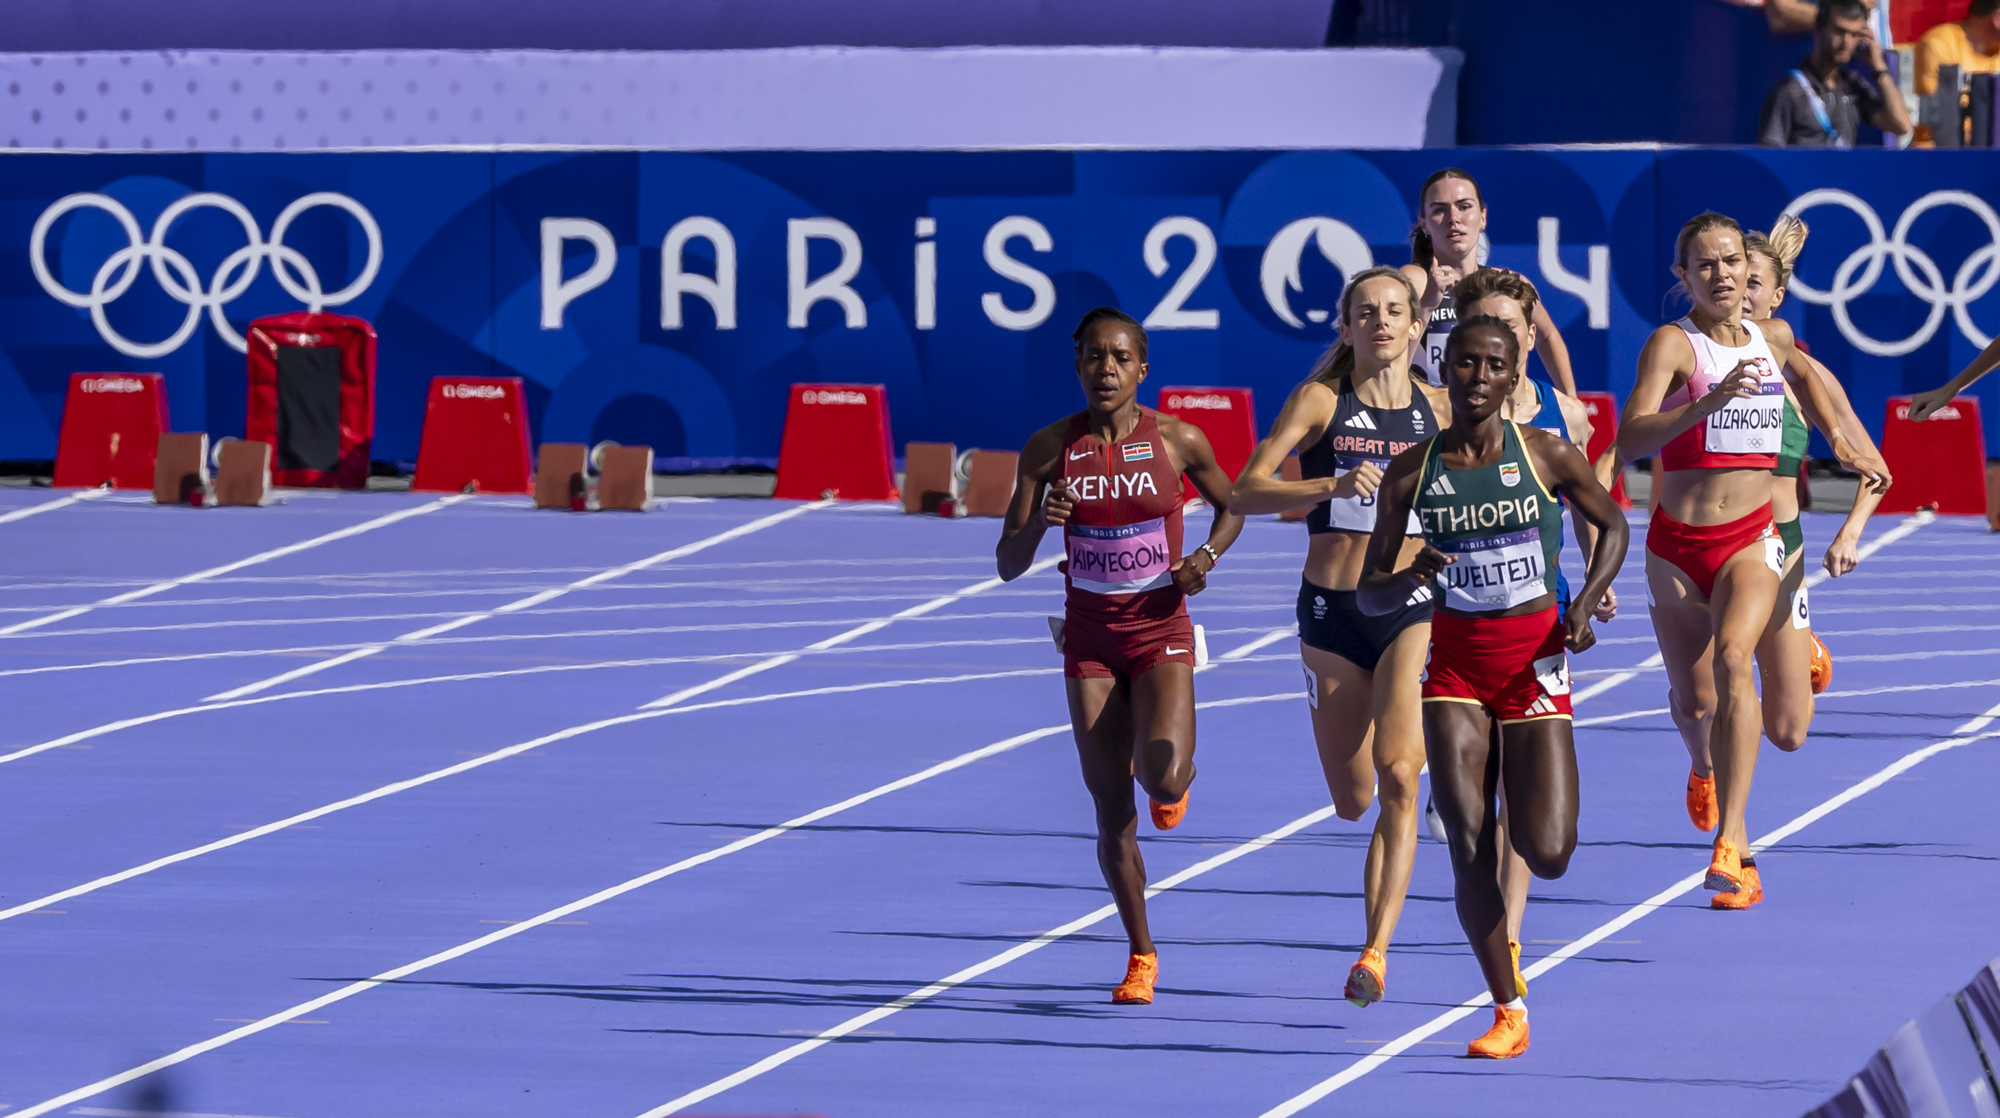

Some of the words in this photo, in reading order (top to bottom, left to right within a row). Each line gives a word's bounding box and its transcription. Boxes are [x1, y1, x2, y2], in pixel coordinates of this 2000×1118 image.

[1141, 215, 1610, 330] 204
[1431, 308, 1457, 321] NEW
[456, 383, 506, 399] OMEGA
[1333, 435, 1385, 455] GREAT
[1066, 471, 1158, 500] KENYA
[1420, 495, 1540, 533] ETHIOPIA
[1073, 543, 1165, 573] KIPYEGON
[1776, 546, 1783, 569] 5
[1447, 555, 1539, 590] WELTEJI
[1799, 597, 1807, 620] 6
